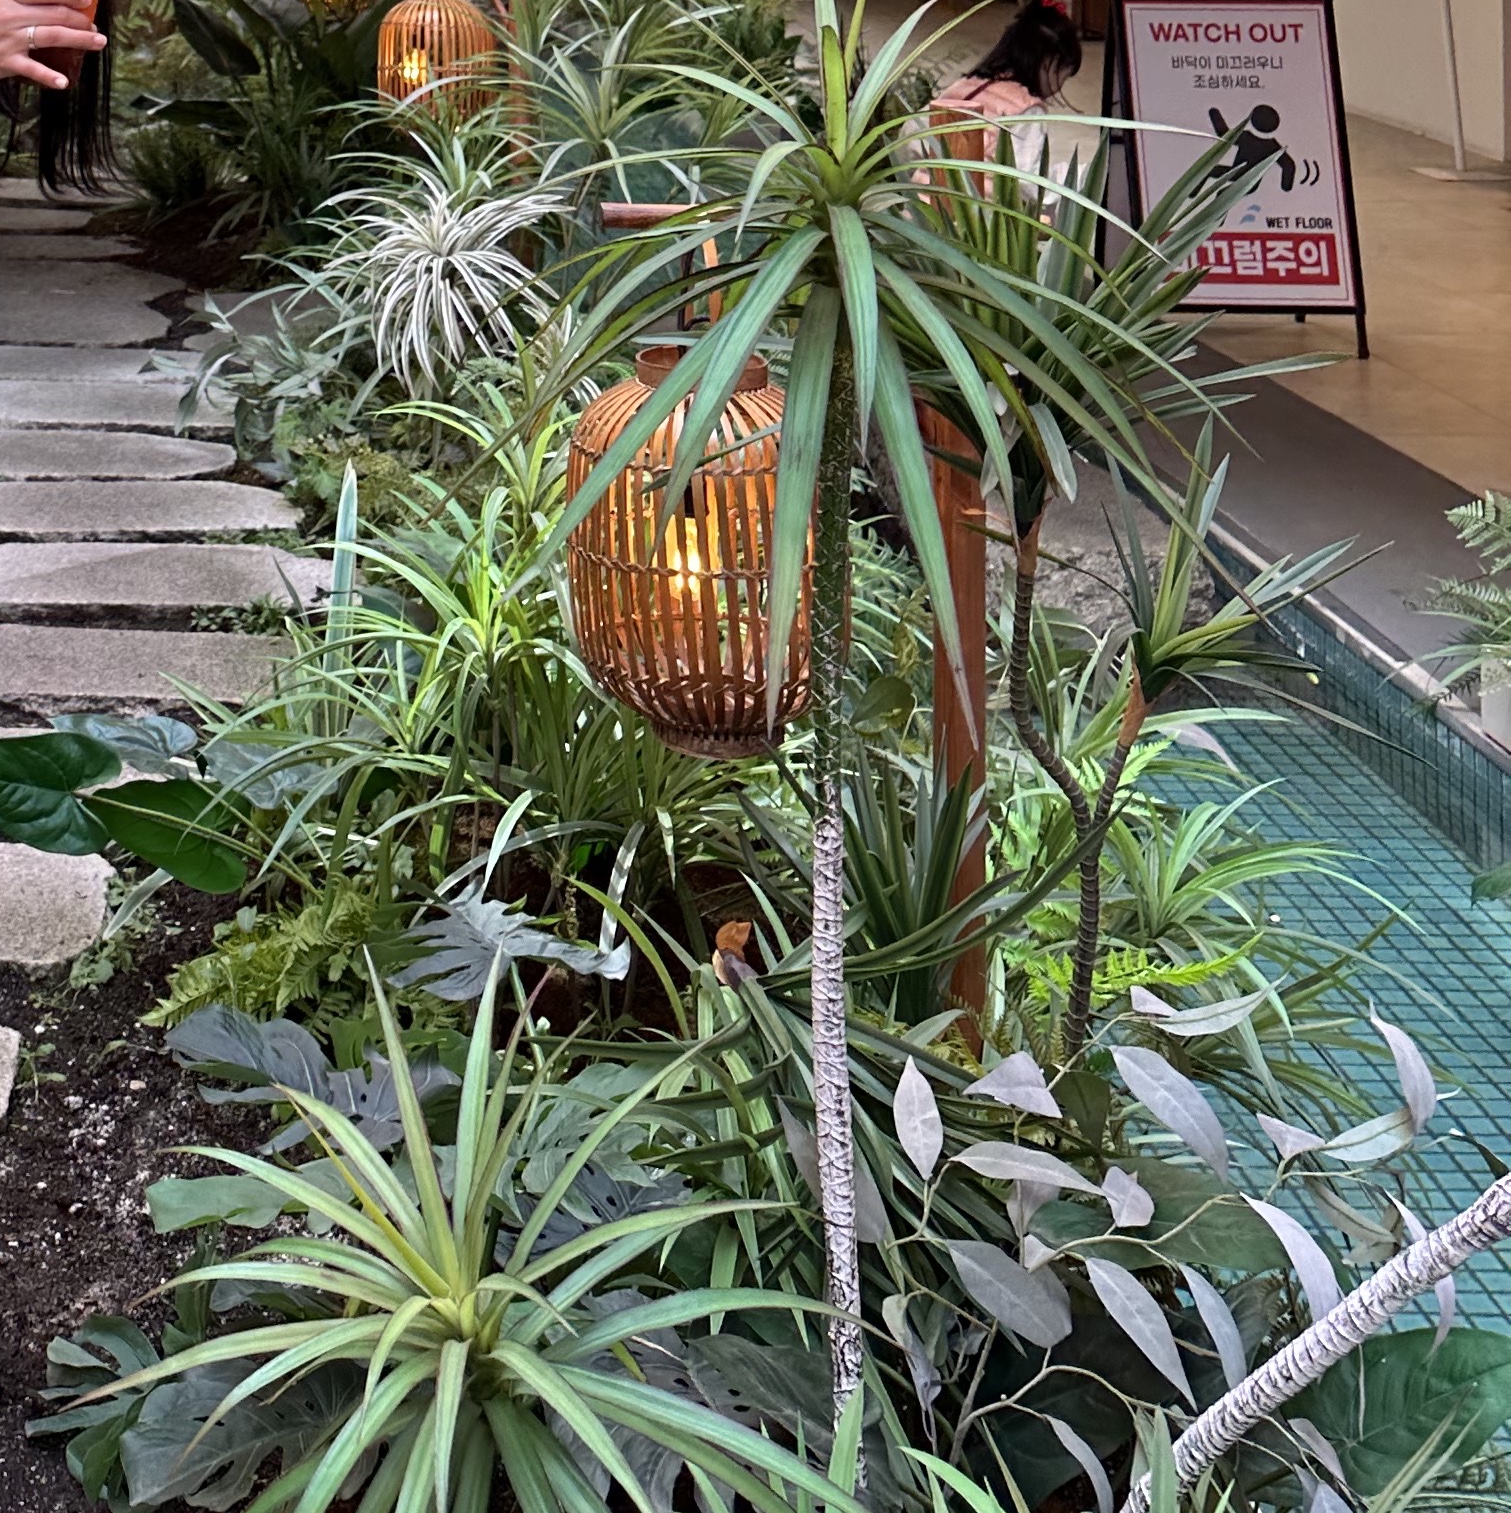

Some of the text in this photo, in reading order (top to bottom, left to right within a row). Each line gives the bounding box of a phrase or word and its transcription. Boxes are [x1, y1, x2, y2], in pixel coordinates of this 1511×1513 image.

[1149, 22, 1304, 43] WATCH OUT
[1171, 55, 1283, 70] 바닥이 미끄러우니
[1265, 216, 1333, 229] WET FLOOR
